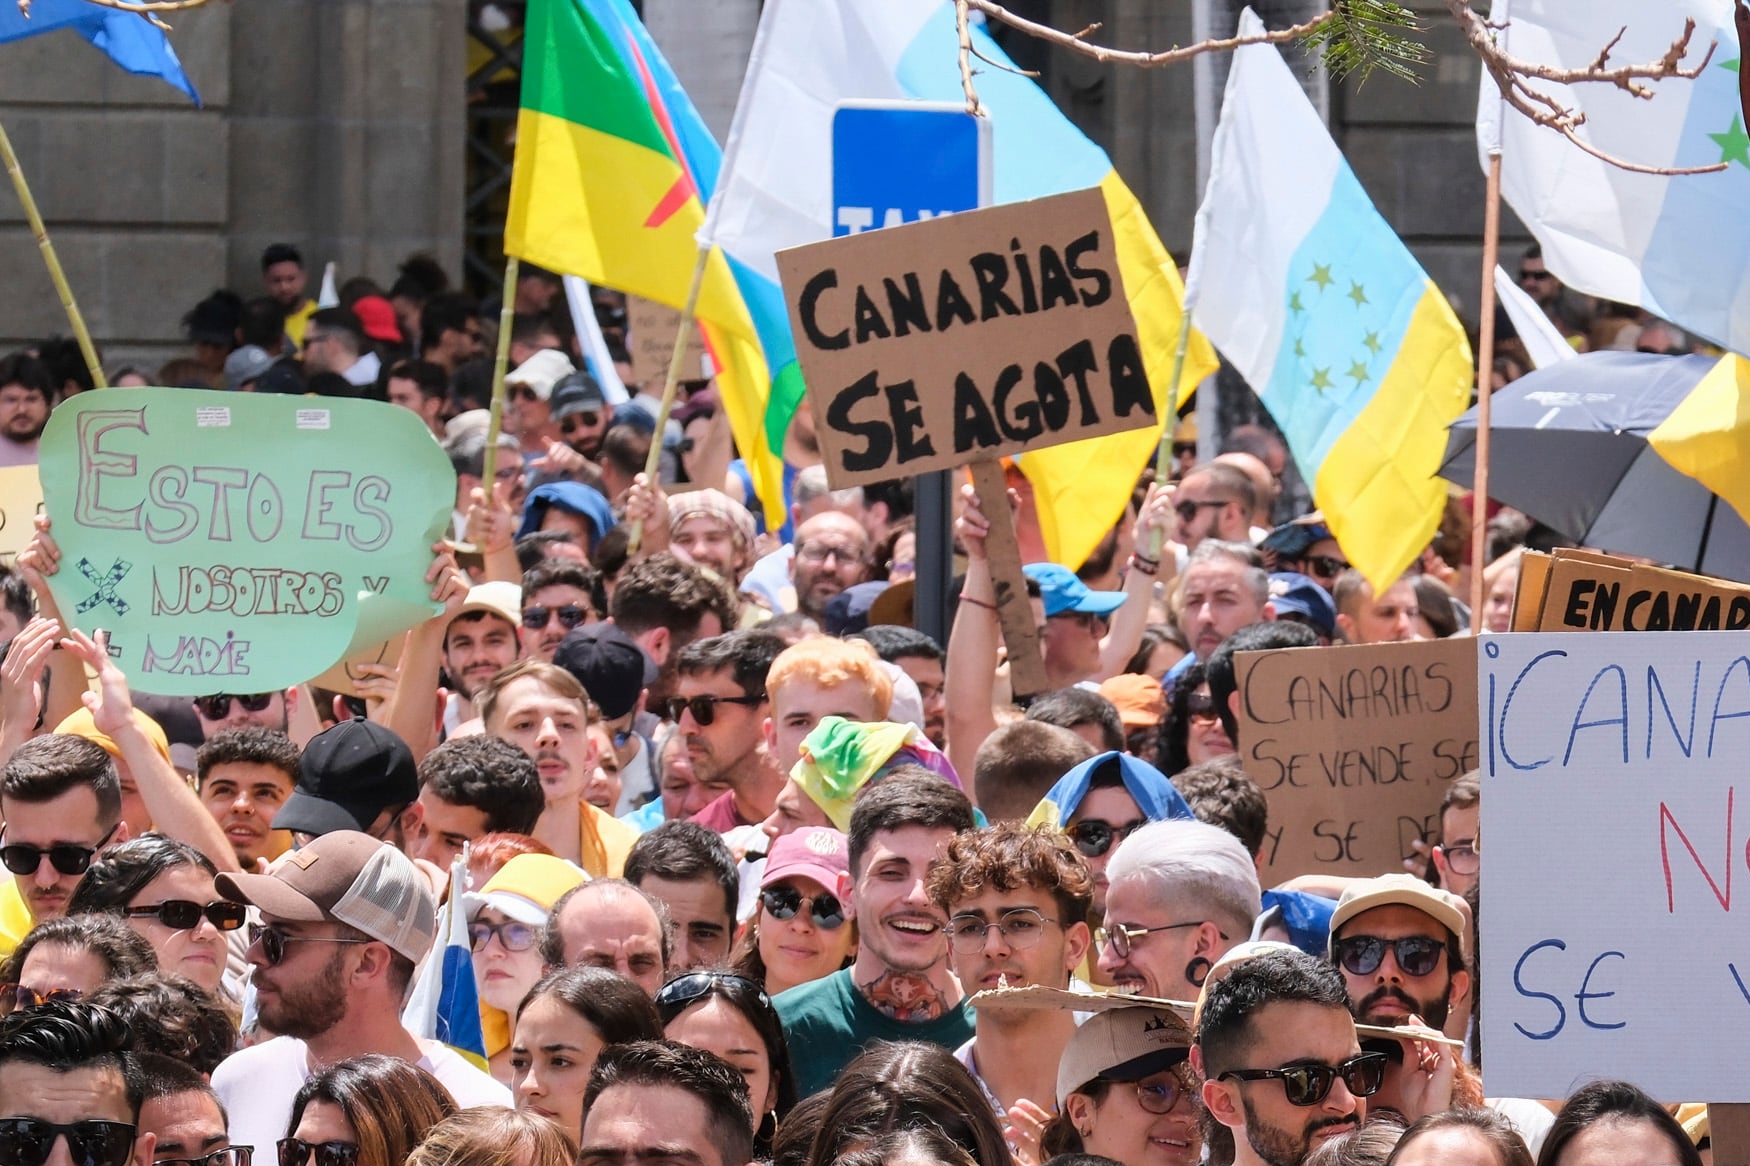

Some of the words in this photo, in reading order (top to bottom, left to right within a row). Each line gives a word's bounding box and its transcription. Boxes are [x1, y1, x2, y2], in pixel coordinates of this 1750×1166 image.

[827, 370, 936, 471] SE
[954, 333, 1155, 454] AGOTA
[74, 404, 283, 544] ESTO
[302, 470, 392, 552] ES
[151, 565, 345, 618] NOSOTROS
[1564, 580, 1620, 630] EN
[142, 630, 250, 675] NADIE
[1245, 651, 1452, 724] CANARIAS
[1252, 739, 1309, 790] SE
[1313, 819, 1364, 863] SE
[1514, 938, 1627, 1041] SE
